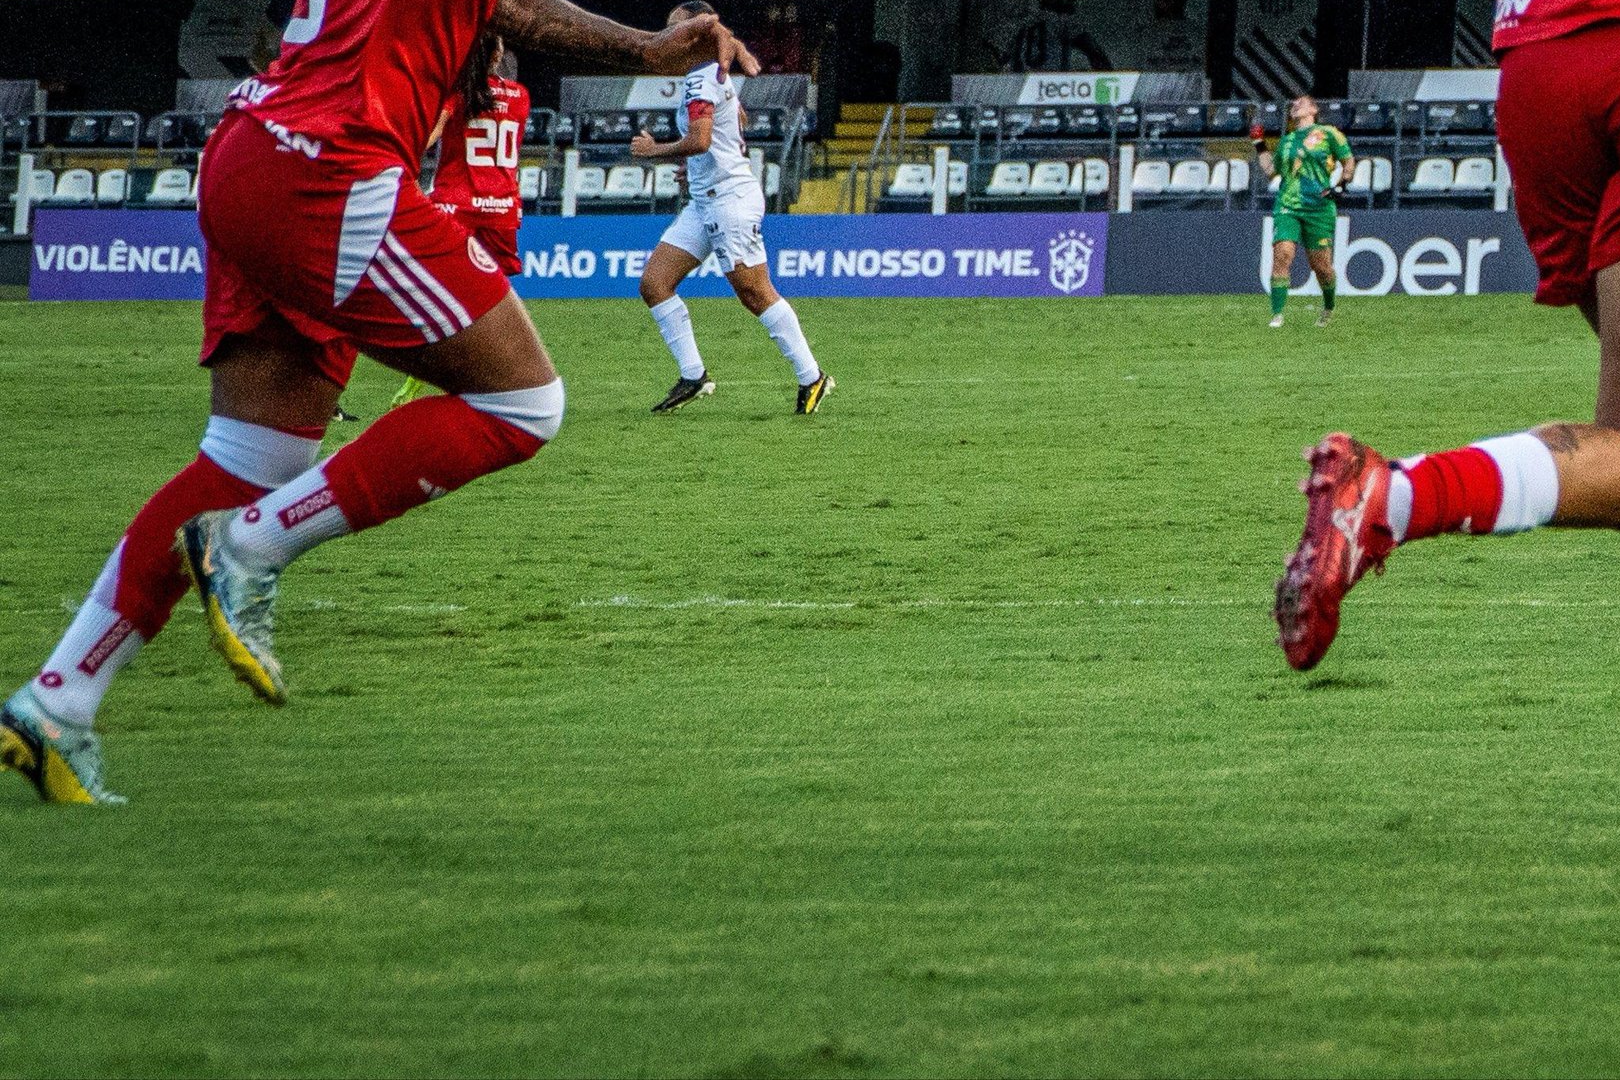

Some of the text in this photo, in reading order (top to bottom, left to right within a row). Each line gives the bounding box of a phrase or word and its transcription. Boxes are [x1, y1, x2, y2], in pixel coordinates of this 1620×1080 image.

[466, 119, 520, 169] 20
[35, 239, 203, 273] VIOLÊNCIA
[523, 243, 597, 278] NÃO
[603, 250, 652, 278] TE
[777, 248, 1040, 278] EM NOSSO TIME.
